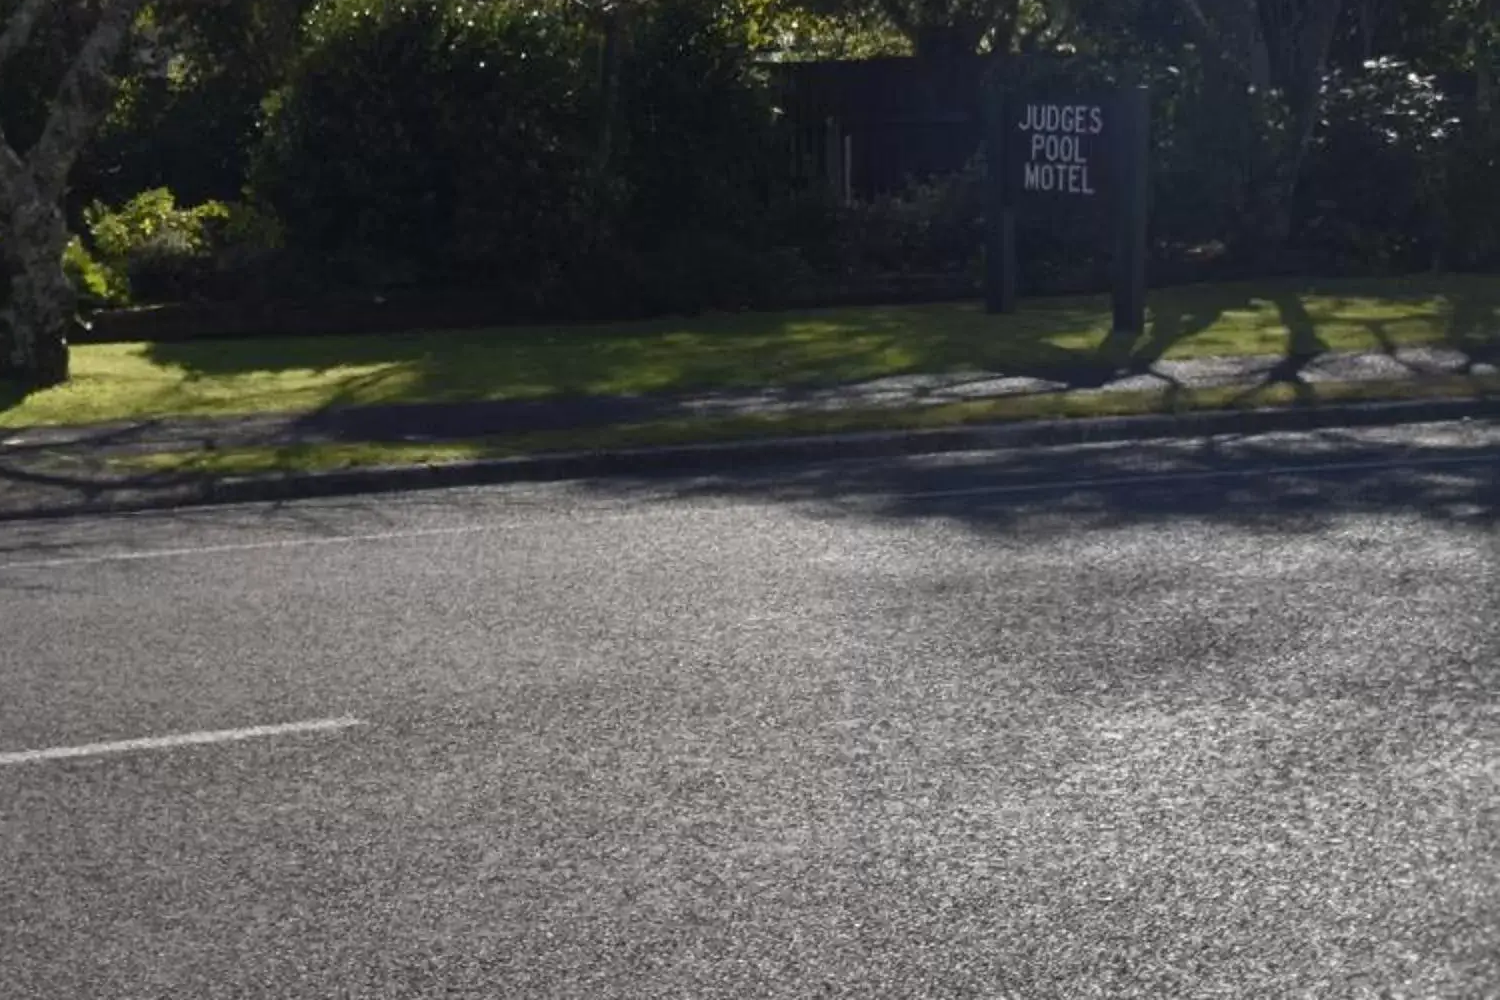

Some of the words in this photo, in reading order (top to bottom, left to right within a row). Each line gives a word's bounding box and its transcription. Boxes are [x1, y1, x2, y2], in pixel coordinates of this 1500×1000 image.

[1019, 104, 1103, 133] JUDGES
[1031, 134, 1087, 163] POOL
[1025, 162, 1095, 194] MOTEL
